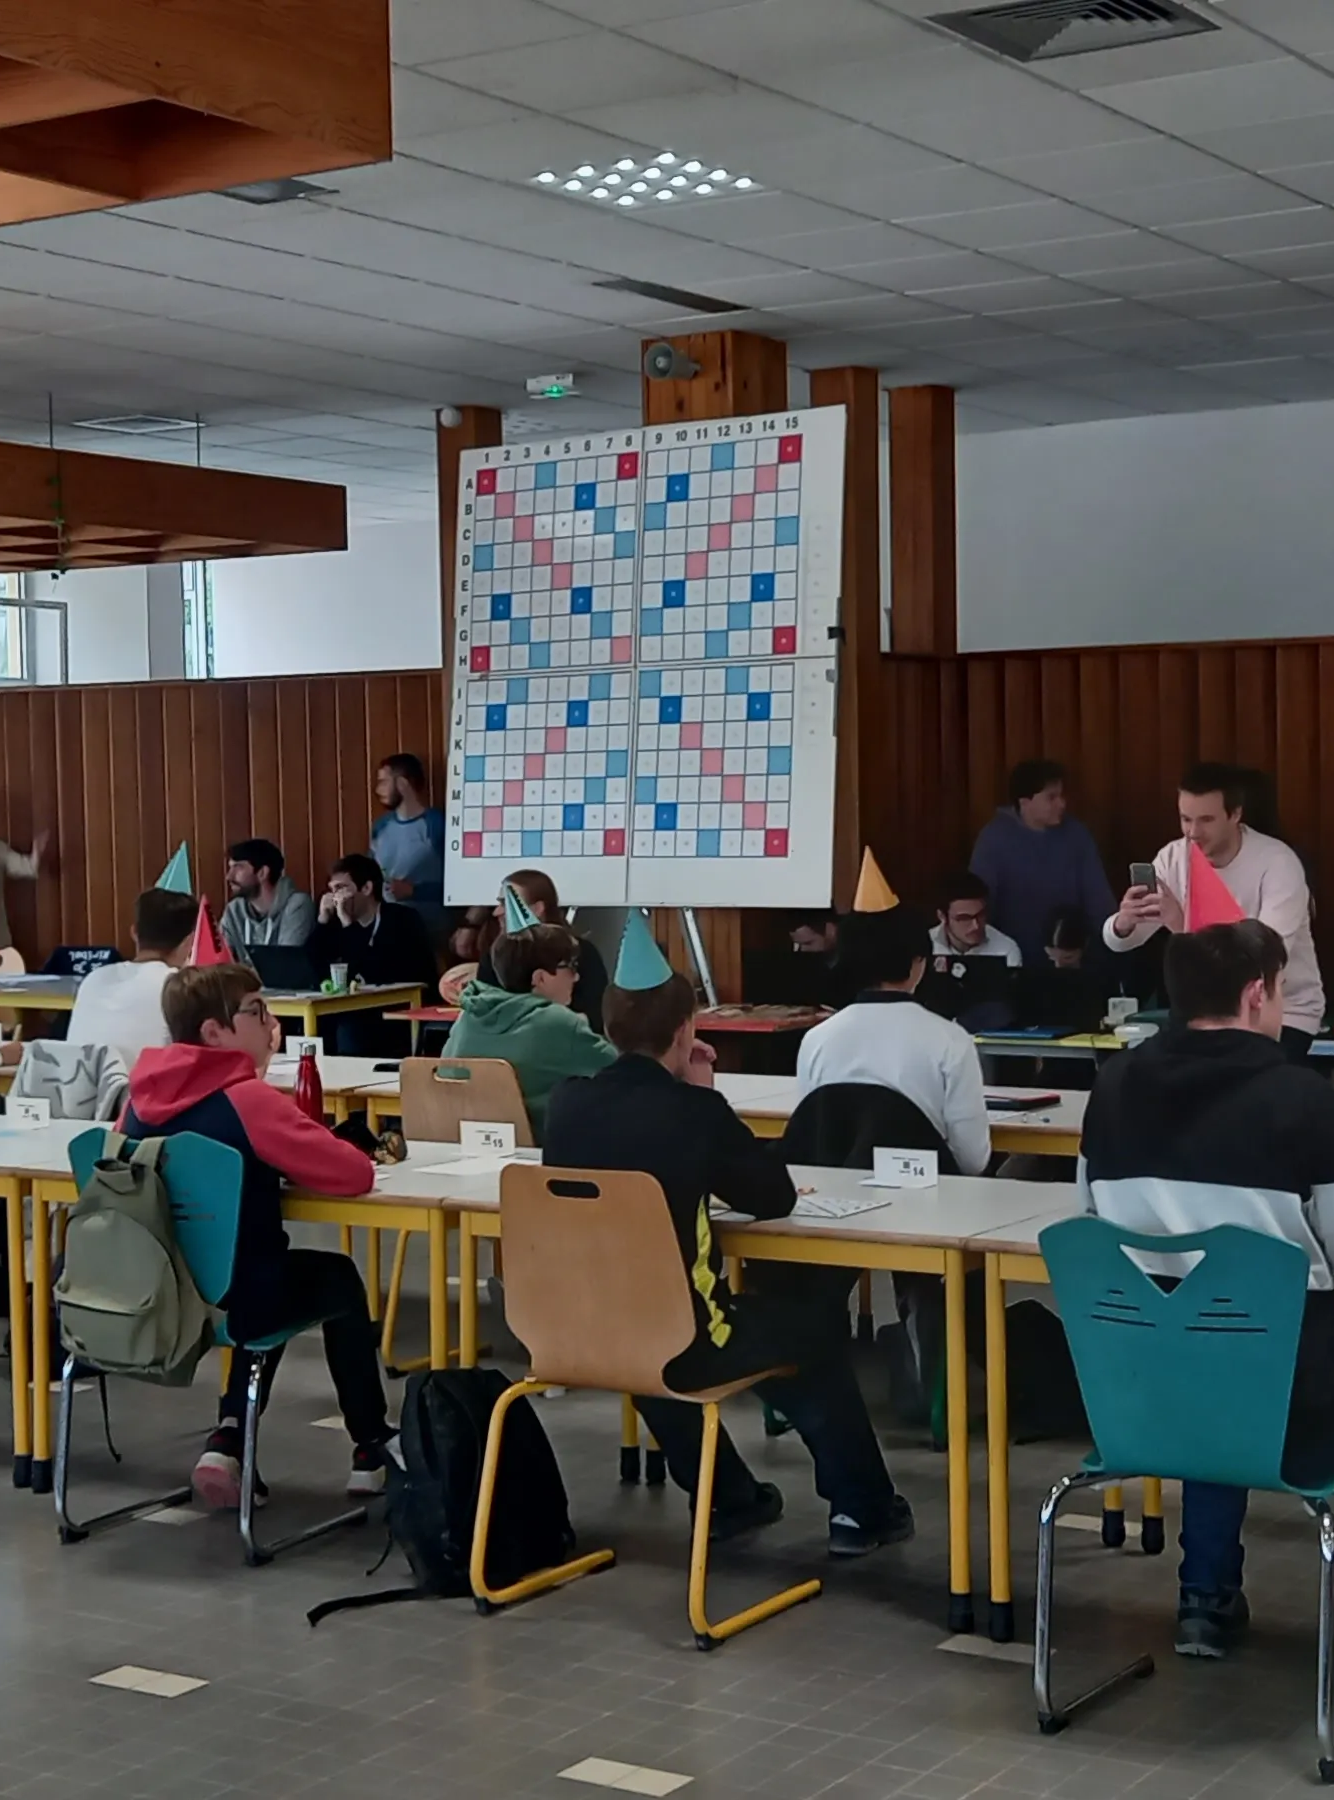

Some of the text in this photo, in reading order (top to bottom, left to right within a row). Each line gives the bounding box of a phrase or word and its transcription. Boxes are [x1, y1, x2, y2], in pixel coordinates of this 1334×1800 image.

[484, 417, 798, 463] 1 2 3 4 5 6 7 8 9 10 11 12 13 14 15
[466, 478, 473, 490] A
[464, 504, 473, 516] B
[462, 528, 471, 540] C
[461, 554, 470, 566] D
[461, 580, 469, 592] E
[460, 605, 468, 617] F
[459, 630, 468, 642] G
[459, 655, 467, 666] H
[455, 714, 463, 726] J
[454, 739, 463, 750] K
[453, 765, 461, 776] L
[452, 815, 460, 827] N
[493, 1138, 503, 1148] 15
[913, 1166, 925, 1177] 14
